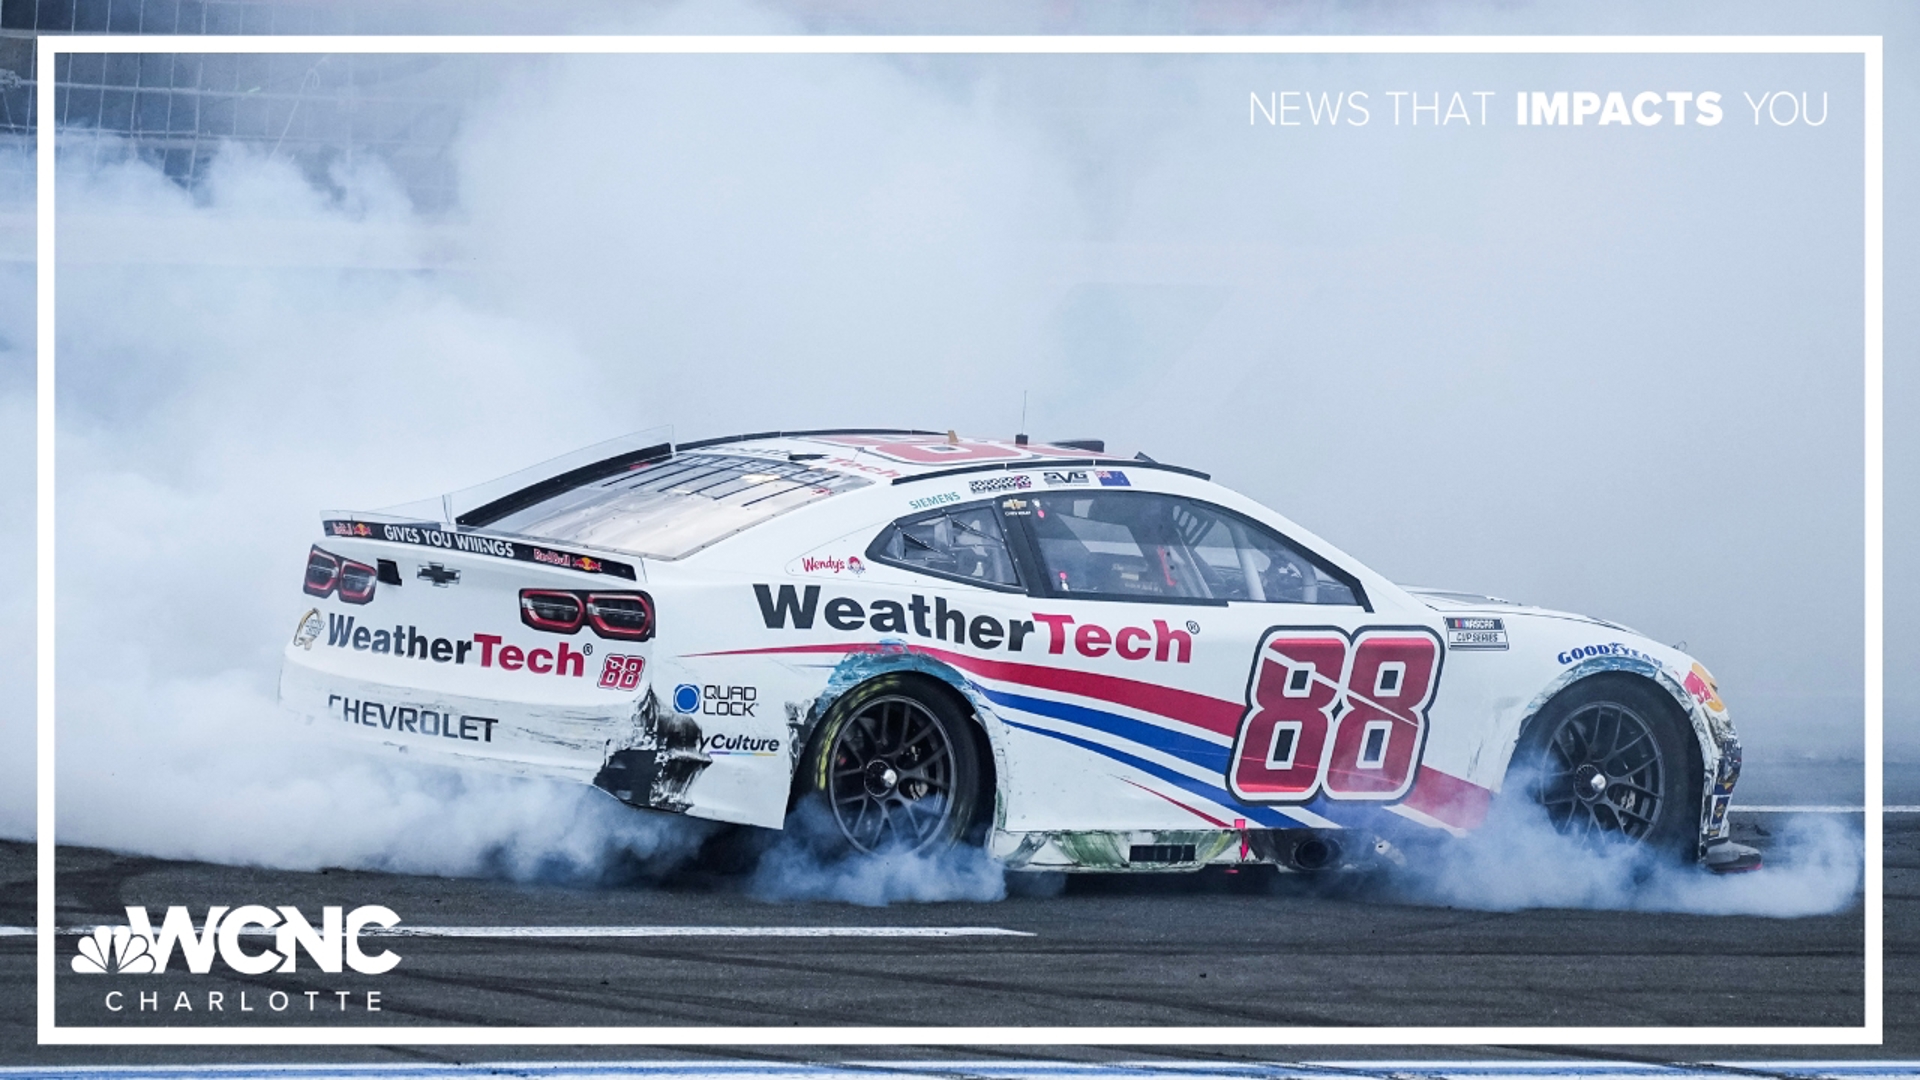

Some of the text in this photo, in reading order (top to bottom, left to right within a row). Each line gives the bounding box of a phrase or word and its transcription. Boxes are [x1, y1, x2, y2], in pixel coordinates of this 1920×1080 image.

[909, 491, 961, 510] SIEMENS
[383, 524, 420, 544] GIVES
[421, 528, 452, 548] YOU
[802, 555, 845, 574] Wendy's
[1464, 619, 1495, 630] NASCAR
[1456, 632, 1498, 643] CUP SERIES
[596, 652, 646, 692] 88
[703, 684, 757, 701] QUAD
[702, 701, 756, 717] LOCK
[1224, 624, 1446, 807] 88
